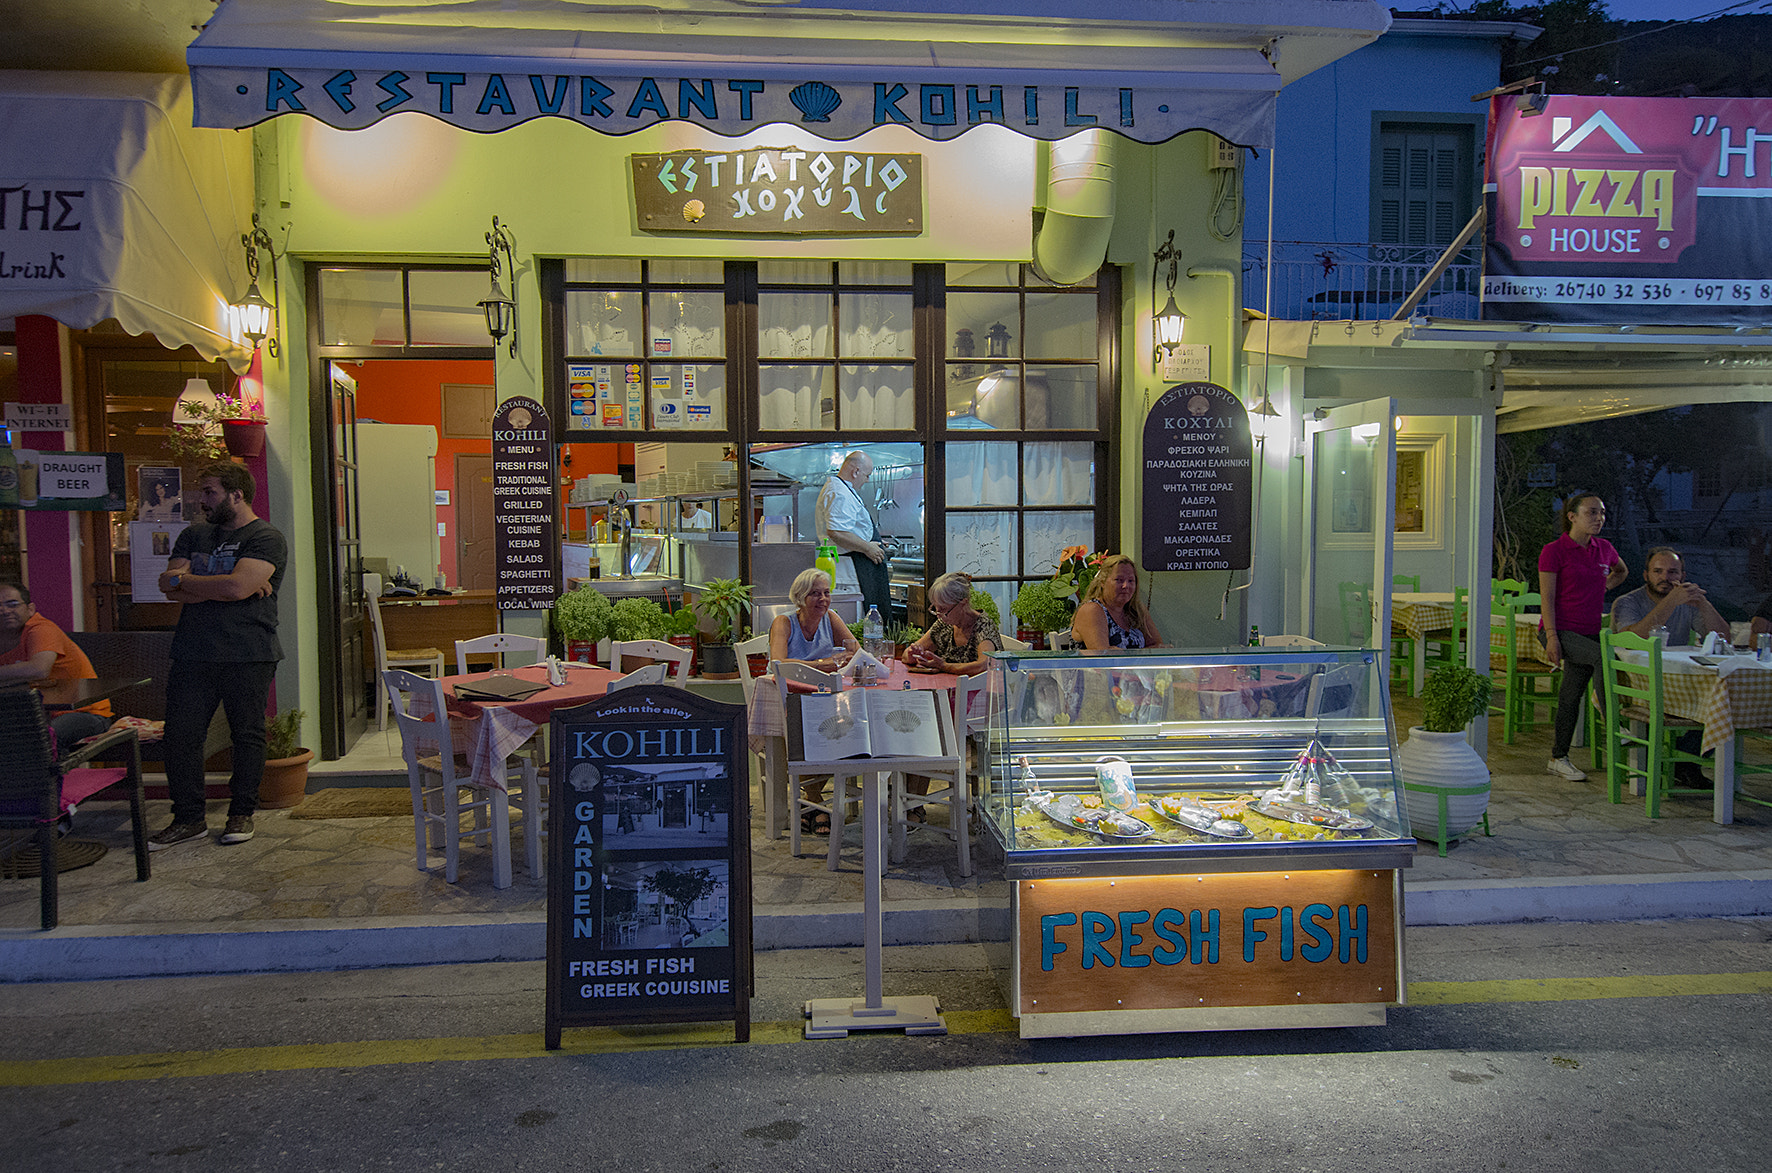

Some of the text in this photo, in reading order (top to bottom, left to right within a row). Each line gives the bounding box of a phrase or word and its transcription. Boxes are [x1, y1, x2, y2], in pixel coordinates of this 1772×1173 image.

[873, 82, 1134, 127] KOHILI
[1517, 166, 1677, 231] PIZZA
[1549, 228, 1641, 253] HOUSE
[1483, 281, 1772, 302] delivery: 26740 32 536 697 85 8
[1160, 386, 1236, 407] ΕΣΤΙΑΤΟΡΙΟ
[494, 400, 547, 418] RESTAURANT
[6, 418, 70, 428] INTERNET
[1164, 417, 1233, 429] ΚΟΧΥΛΙ
[494, 430, 547, 441] KOHILI
[1182, 433, 1216, 441] ΜΕΝΟΥ
[507, 446, 535, 454] MENU
[1167, 446, 1230, 455] ΦΡΕΣΚΟ ΨΑΡΙ
[43, 463, 103, 473] DRAUGHT
[495, 461, 549, 470] FRESH FISH
[1146, 459, 1250, 469] ΠΑΡΑΔΟΣΙΑΚΗ ΕΛΛΗΝΙΚΗ
[1180, 470, 1217, 478] ΚΟΥΖΙΝΑ
[57, 479, 90, 490] BEER
[497, 476, 548, 484] TRADITIONAL
[494, 486, 552, 496] GREEK CUISINE
[1163, 483, 1234, 492] ΨΗΤΑ ΤΗΣ ΩΡΑΣ
[1181, 496, 1216, 505] ΛΑΔΕΡΑ
[503, 501, 543, 510] GRILLED
[1179, 509, 1218, 518] ΚΕΜΠΑΠ
[496, 514, 552, 523] VEGETERIAN
[506, 526, 542, 534] CUISINE
[1178, 522, 1218, 531] ΣΑΛΑΤΕΣ
[508, 540, 541, 548] KEBAB
[1164, 535, 1232, 544] ΜΑΚΑΡΟΝΑΔΕΣ
[1175, 548, 1221, 557] ΟΡΕΚΤΙΚΑ
[506, 555, 544, 564] SALADS
[1166, 561, 1229, 570] ΚΡΑΣΙ ΝΤΟΠΙΟ
[500, 570, 551, 579] SPAGHETTI
[498, 585, 555, 594] APPETIZERS
[498, 600, 555, 610] LOCAL WINE
[596, 706, 628, 718] Look
[641, 706, 661, 714] the
[662, 707, 692, 720] alley
[573, 728, 725, 760] KOHILI
[573, 801, 595, 939] GARDEN
[1041, 903, 1368, 972] FRESH FISH
[569, 957, 695, 978] FRESH FISH
[580, 979, 730, 998] GREEK COUISINE
